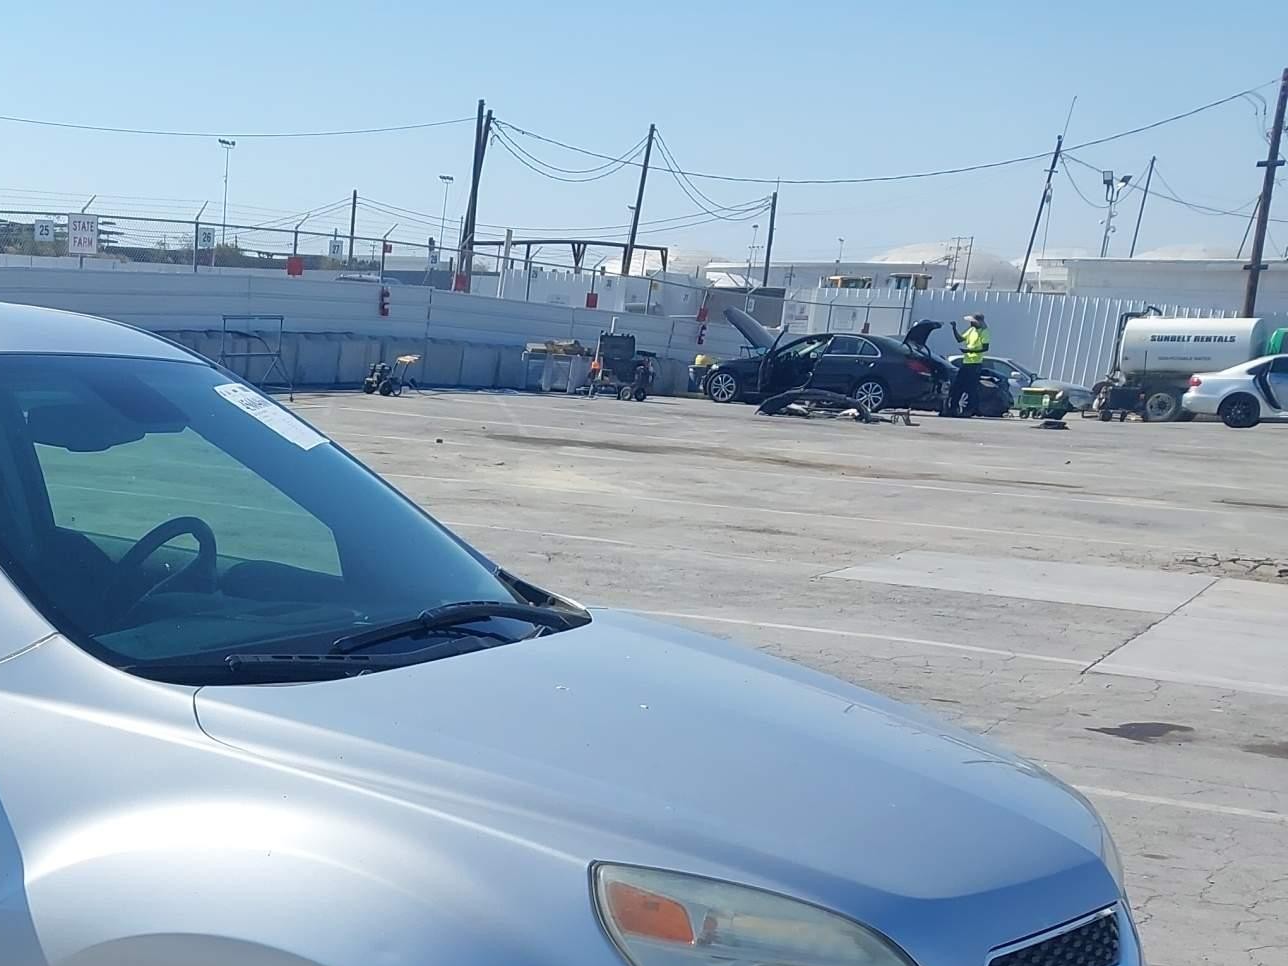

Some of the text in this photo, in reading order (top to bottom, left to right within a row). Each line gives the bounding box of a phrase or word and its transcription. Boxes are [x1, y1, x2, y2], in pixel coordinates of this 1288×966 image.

[39, 224, 50, 236] 25
[72, 220, 94, 232] STATE
[73, 236, 93, 248] FARM
[202, 231, 212, 243] 26
[1193, 335, 1236, 343] RENTALS
